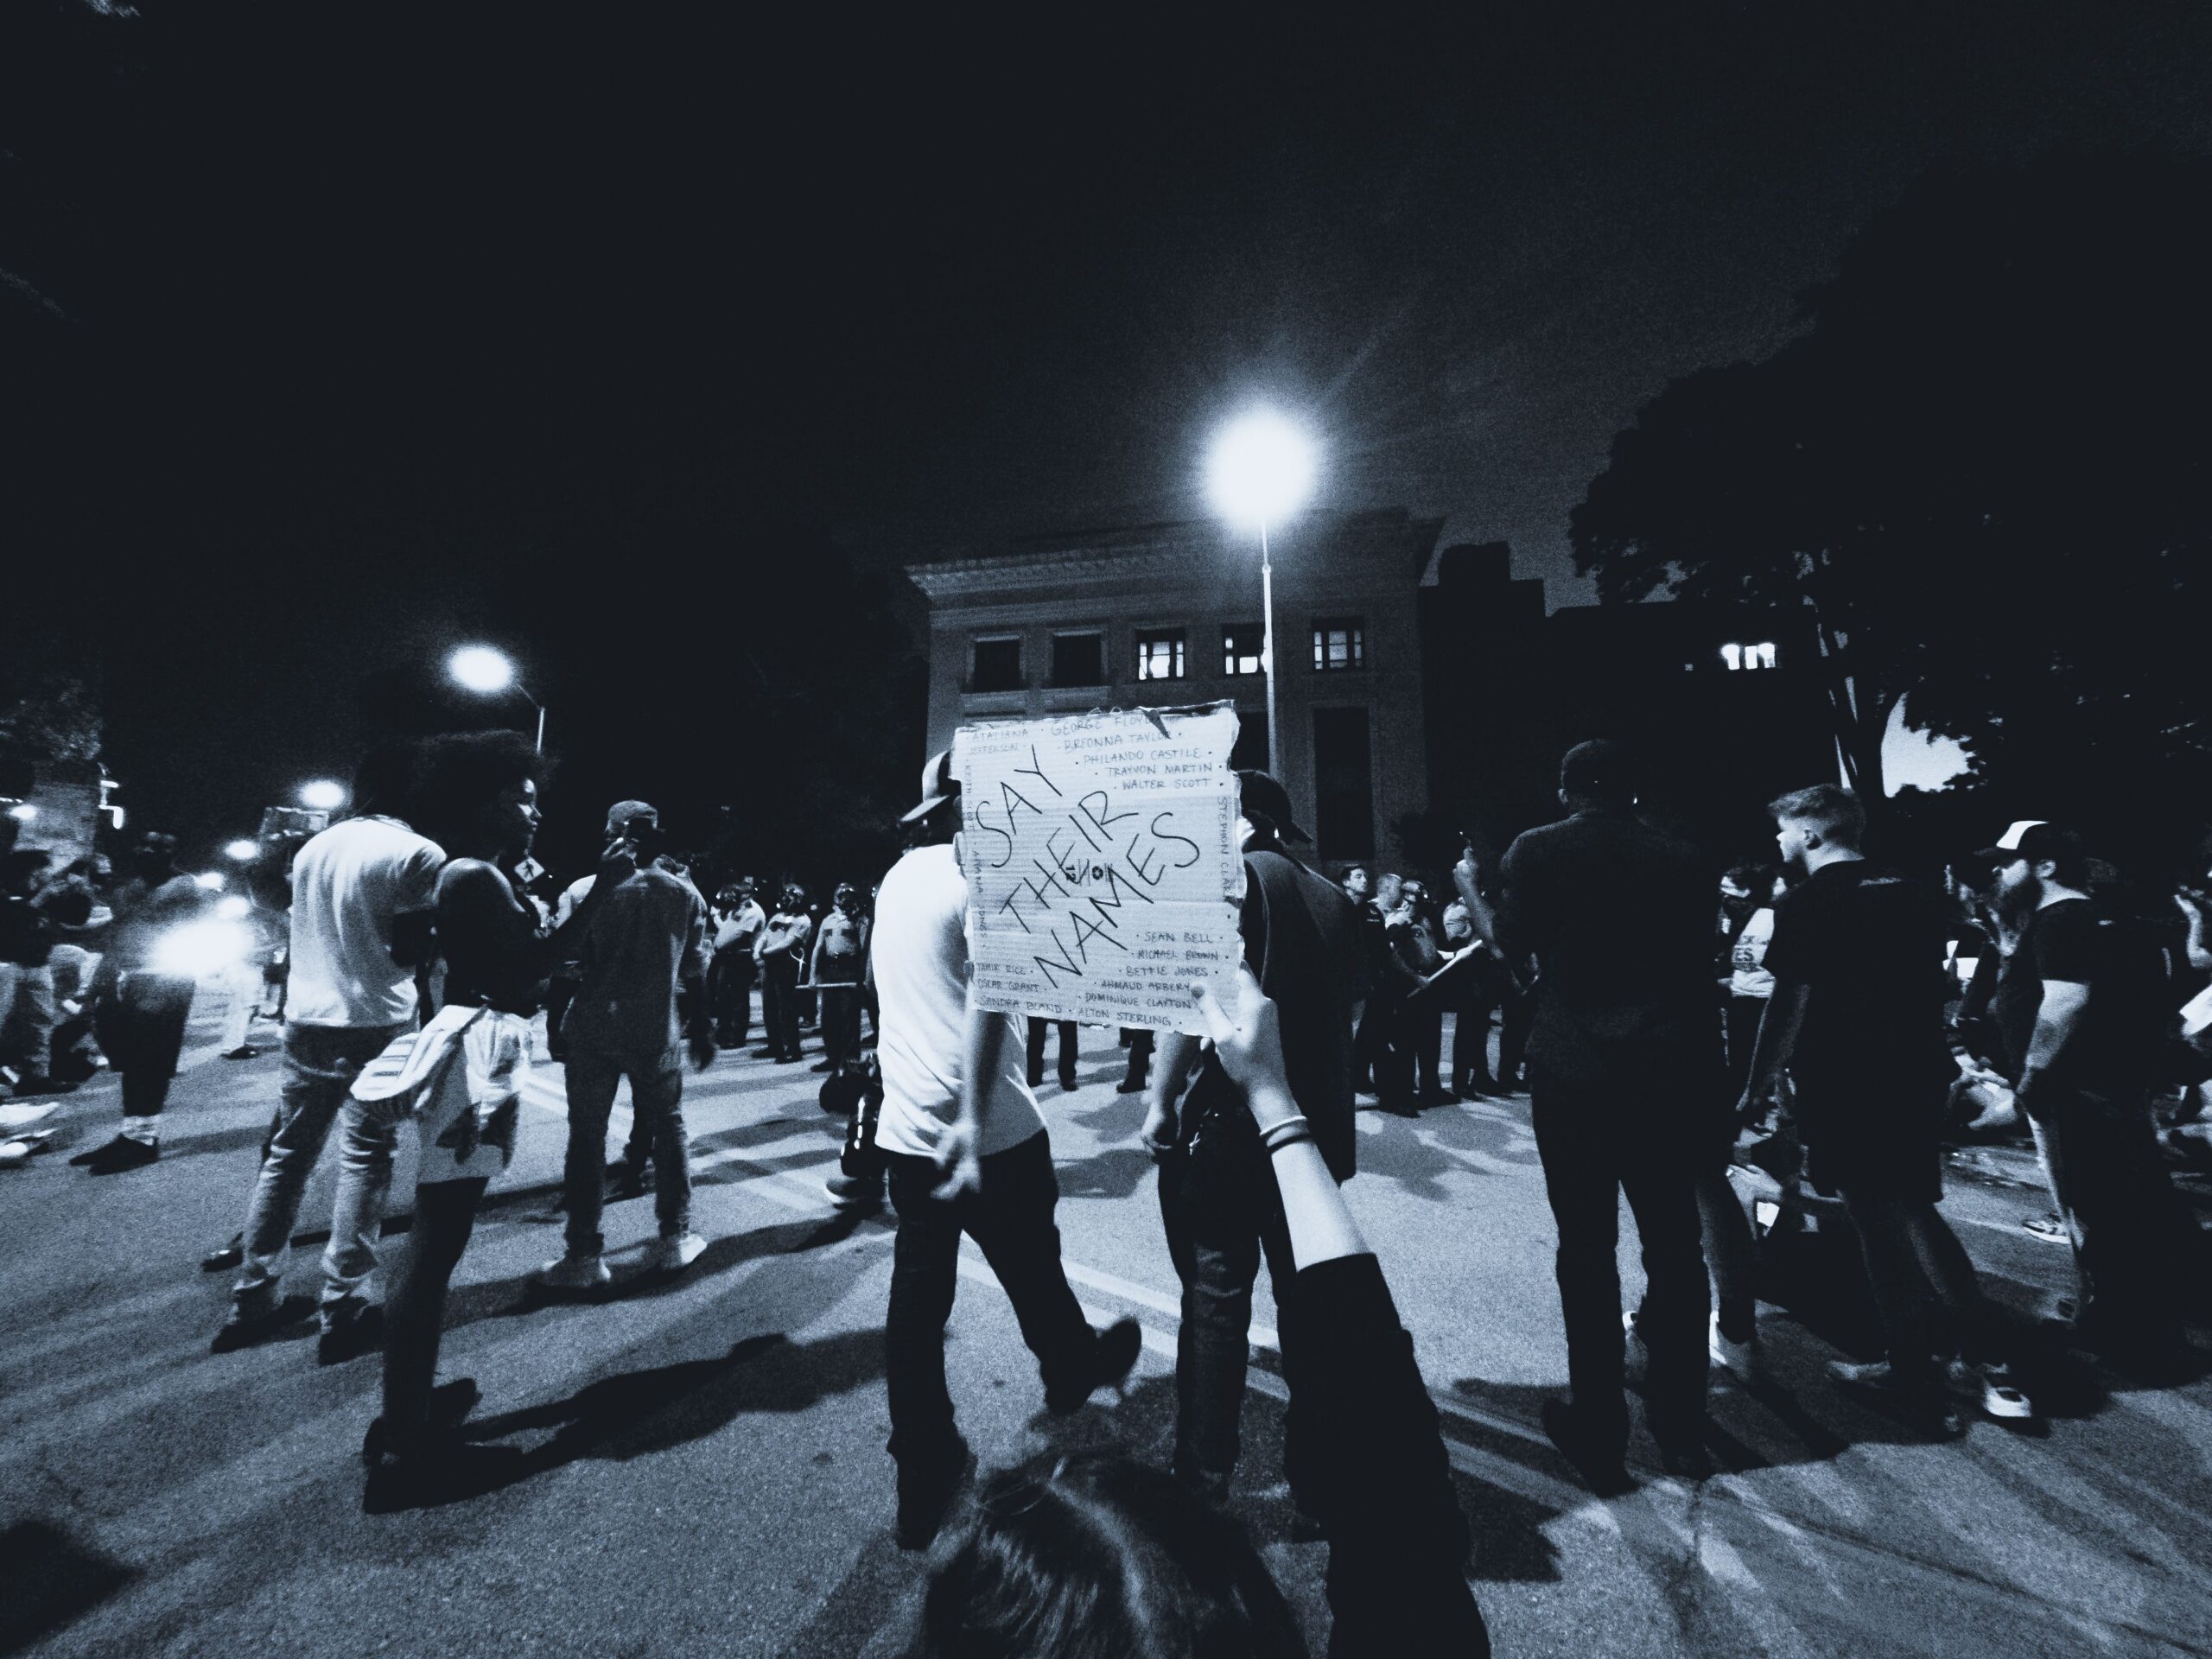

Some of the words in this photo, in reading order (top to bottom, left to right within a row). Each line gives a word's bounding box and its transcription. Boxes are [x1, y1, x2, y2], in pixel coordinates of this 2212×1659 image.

[1064, 734, 1122, 753] BREONNA
[1084, 750, 1143, 765] PHILANDO
[1151, 748, 1202, 760] CASTILE
[1108, 765, 1156, 777] TRAYVON
[1164, 763, 1212, 774] MARTIN
[1122, 779, 1166, 791] WALTER
[1175, 779, 1211, 788] SCOTT
[976, 743, 1063, 868] SAY
[1217, 796, 1229, 855] STEPHON
[999, 790, 1139, 934] THEIR
[1033, 812, 1199, 989] NAMES
[1145, 931, 1175, 943] SEAN
[1184, 931, 1213, 944] BELL
[1126, 966, 1167, 976] BETTIE
[1175, 966, 1209, 977] JONES
[1101, 980, 1143, 991] AHMAUD
[979, 995, 1020, 1008] SANDRA
[1116, 1012, 1172, 1027] STERLING
